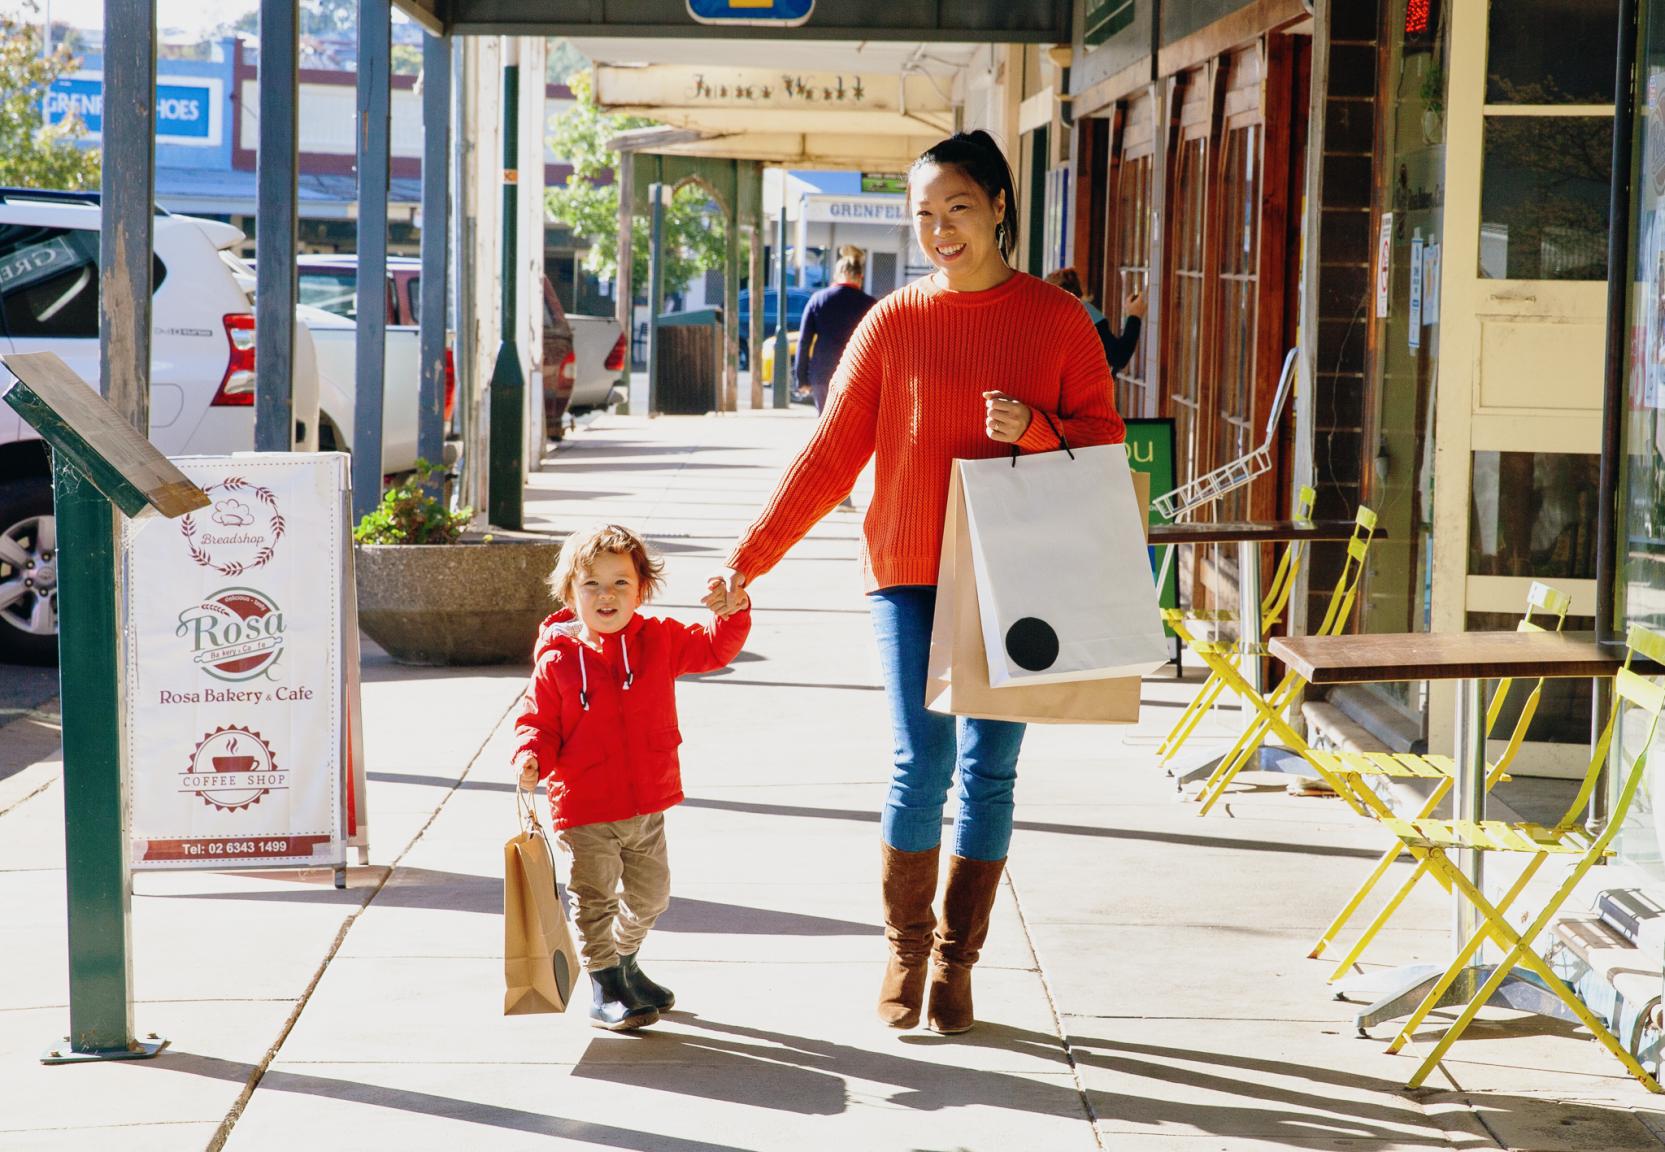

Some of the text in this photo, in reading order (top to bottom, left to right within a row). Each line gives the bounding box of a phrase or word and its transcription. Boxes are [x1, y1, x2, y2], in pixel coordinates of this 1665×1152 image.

[156, 98, 200, 121] HOES
[829, 203, 904, 219] GRENFEL
[201, 532, 265, 547] Breadshop
[176, 606, 287, 652] Rosa
[159, 686, 313, 705] Rosa Bakery & Cafe
[182, 774, 286, 787] COFFEE SHOP
[182, 840, 287, 855] Tel: 02 6343 1499
